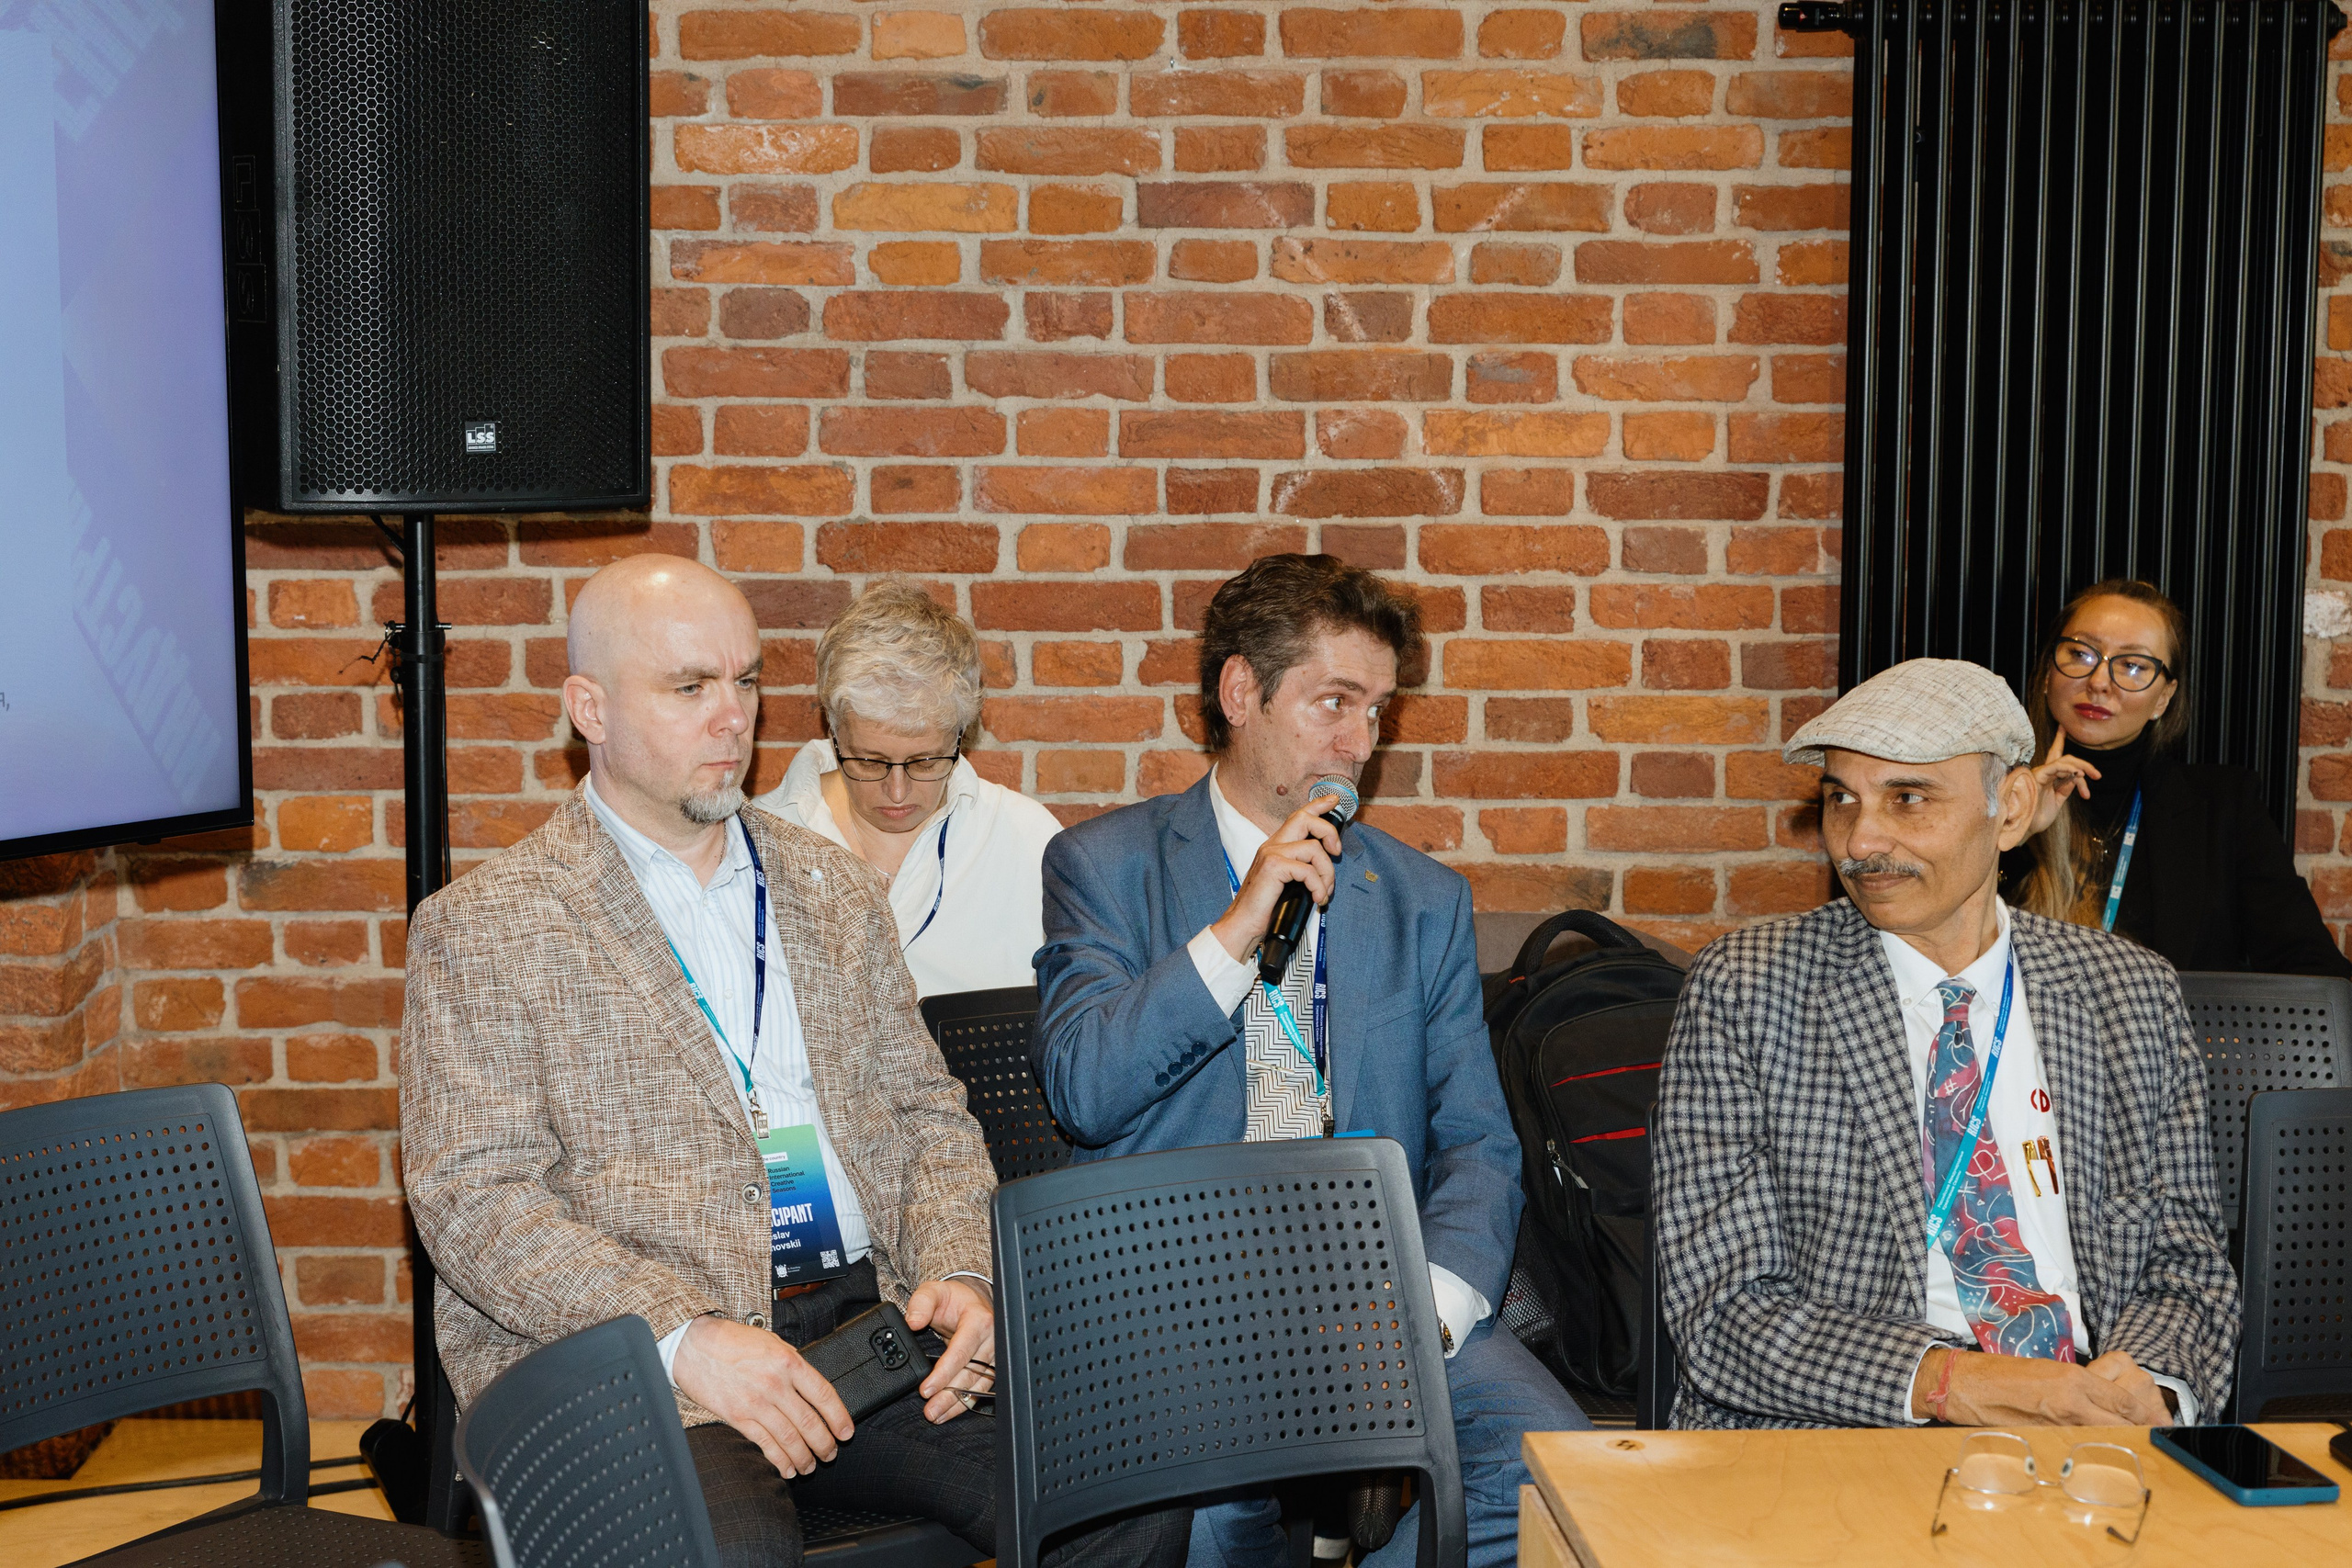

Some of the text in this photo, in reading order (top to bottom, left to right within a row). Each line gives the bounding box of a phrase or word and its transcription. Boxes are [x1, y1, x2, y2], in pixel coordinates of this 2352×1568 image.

[467, 432, 495, 444] LSS
[756, 941, 765, 961] RICS
[1268, 988, 1284, 1009] RICS
[1314, 982, 1327, 999] RICS
[1991, 1035, 2002, 1058] RICS
[1966, 1114, 1982, 1137] RICS
[769, 1170, 805, 1180] International
[1927, 1213, 1943, 1237] RICS
[771, 1231, 790, 1240] slav
